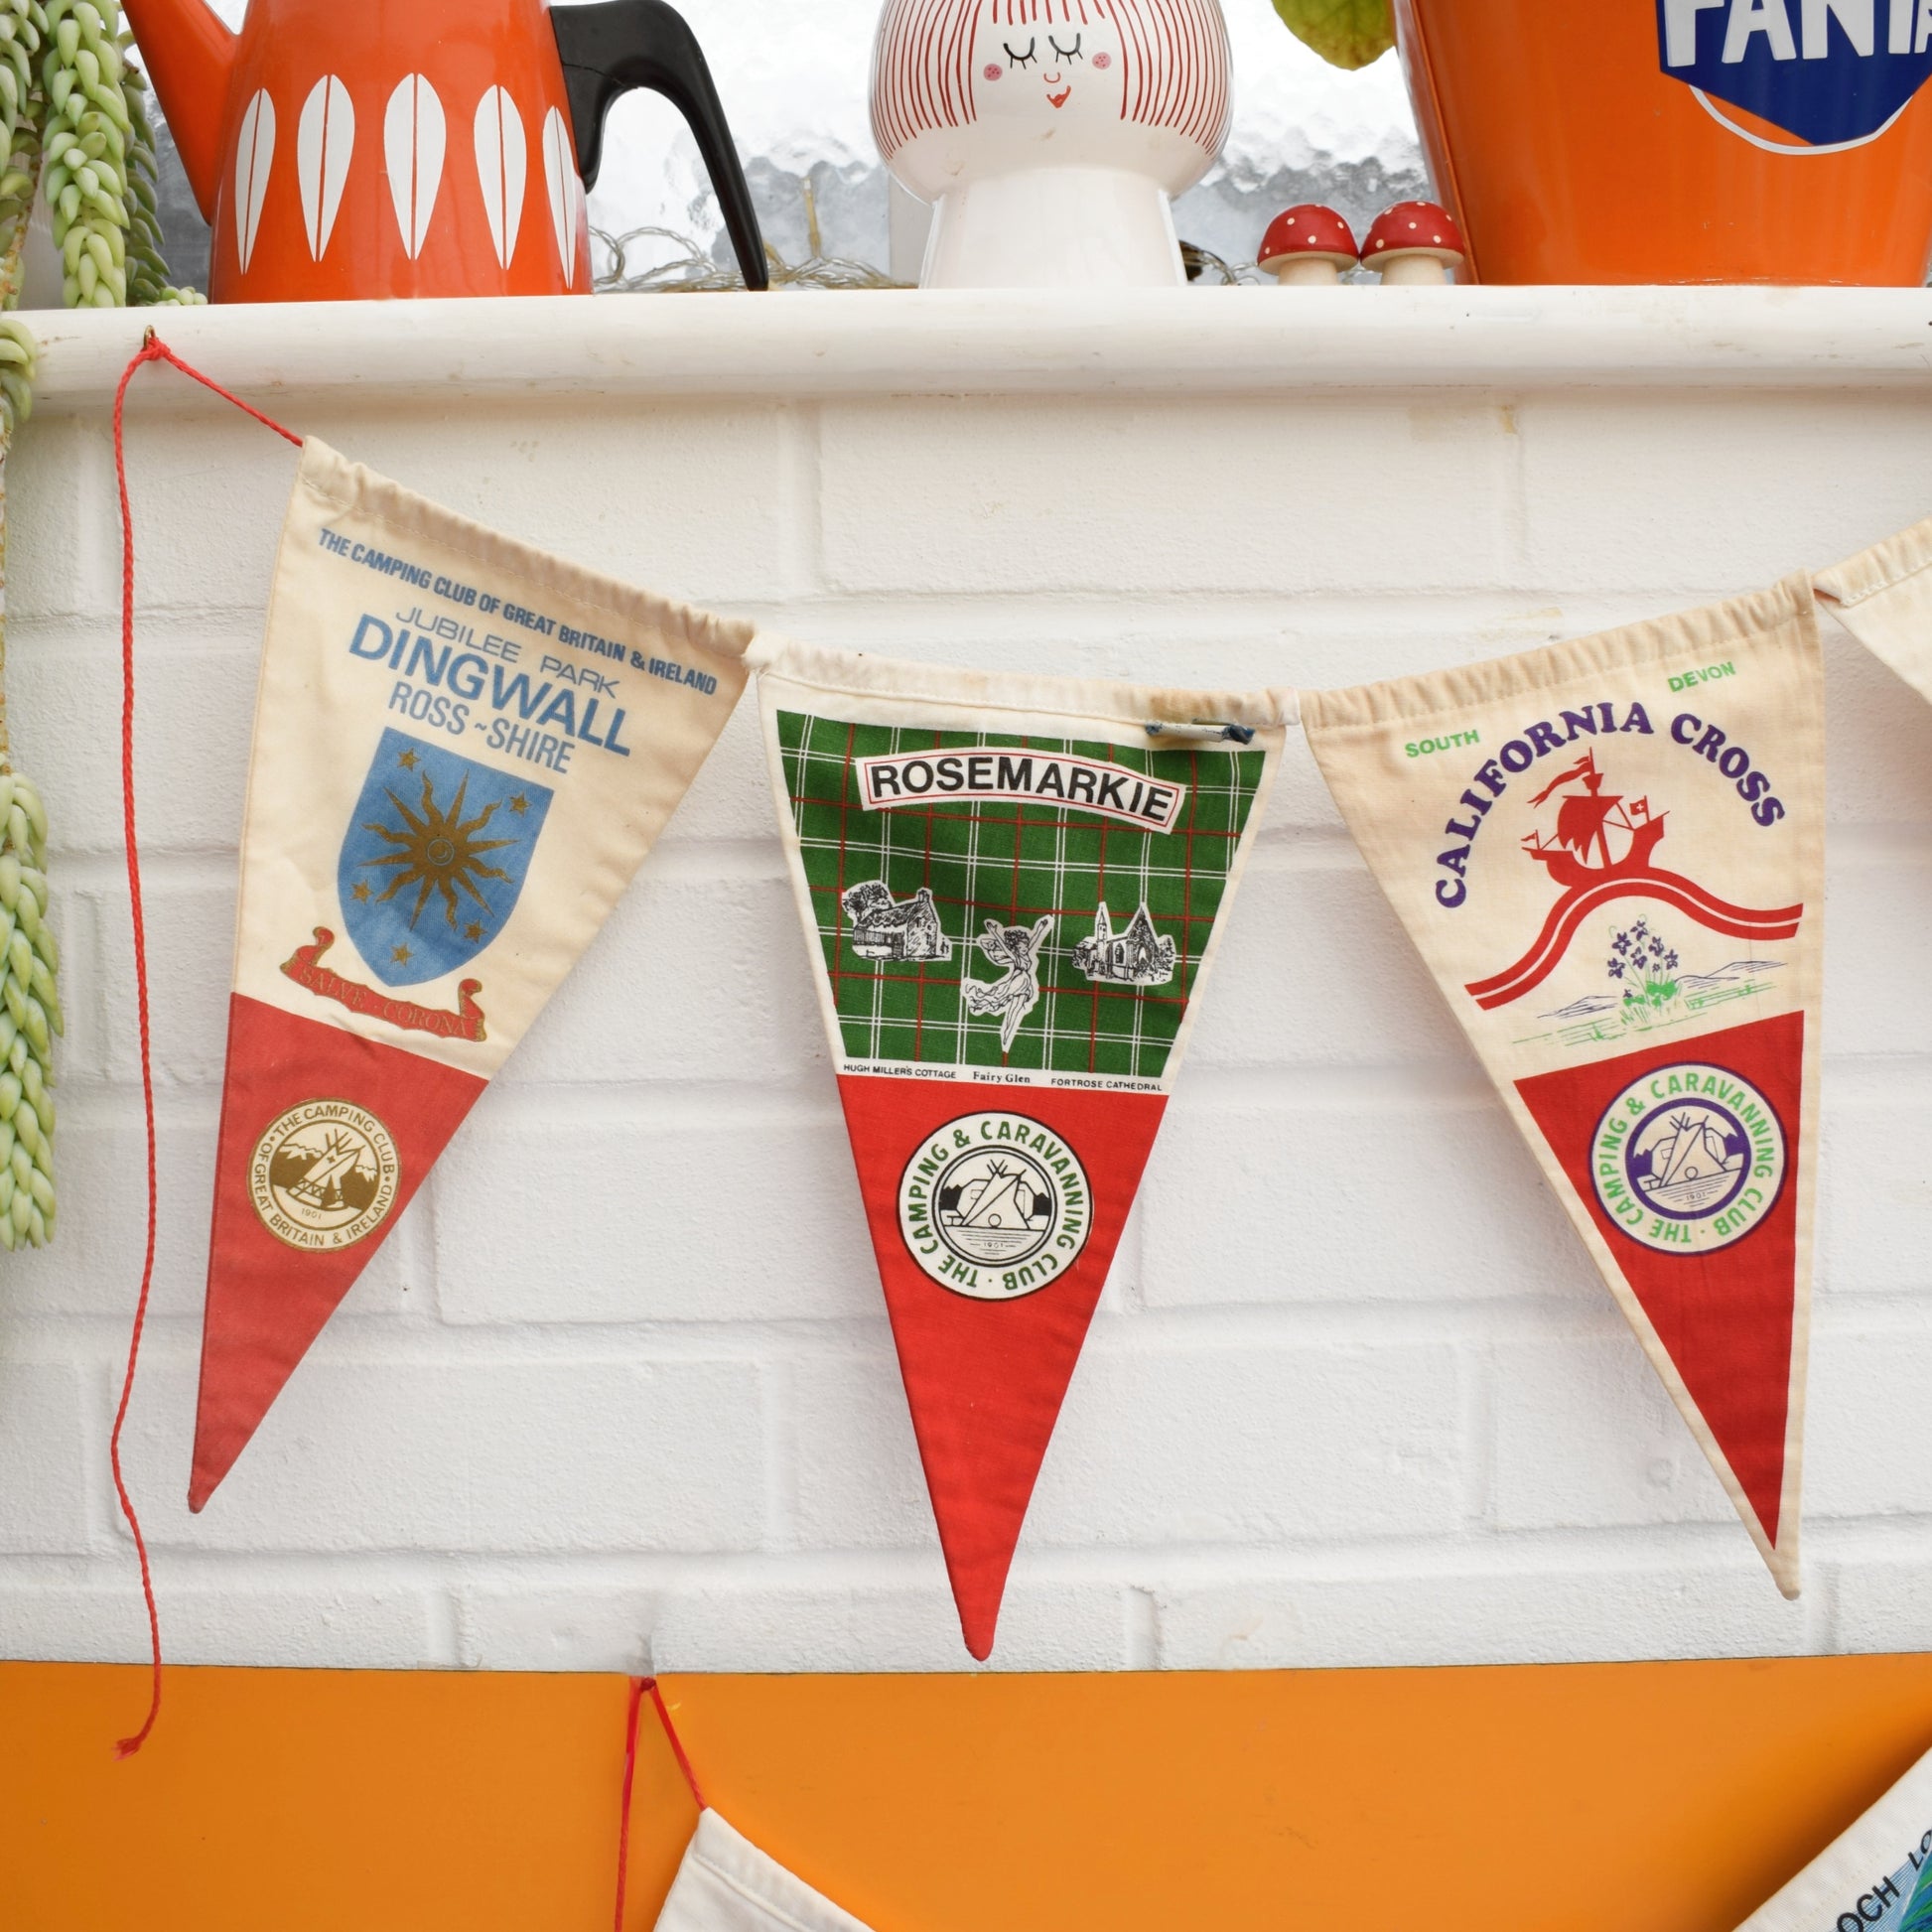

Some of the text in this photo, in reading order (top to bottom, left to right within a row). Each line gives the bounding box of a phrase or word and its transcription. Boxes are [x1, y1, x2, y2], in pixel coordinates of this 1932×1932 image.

[319, 528, 717, 695] THE CAMPING CLUB OF GREAT BRITAIN & IRELAND
[349, 613, 629, 757] DINGWALL
[395, 607, 620, 699] JUBILEE PARK
[1667, 661, 1736, 693] DEVON
[388, 681, 470, 736] ROSS
[1405, 729, 1479, 759] SOUTH
[870, 756, 1173, 822] ROSEMARKIE
[1436, 701, 1786, 908] CALIFORNIA CROSS
[299, 966, 469, 1036] SALVE CORONA
[843, 1063, 957, 1079] HUGH MILLER'S COTTAGE
[973, 1070, 1031, 1083] Fairy Glen
[1050, 1077, 1163, 1092] FORTROSE CATHEDRAL
[273, 1104, 395, 1174] THE CAMPING CLUB
[1598, 1072, 1774, 1243] THE CAMPING & CARAVANNING CLUB
[254, 1143, 393, 1247] OF GREAT BRITAIN & IRELAND
[301, 1206, 322, 1221] 1901
[907, 1120, 1084, 1291] THE CAMPING & CARAVANNING CLUB
